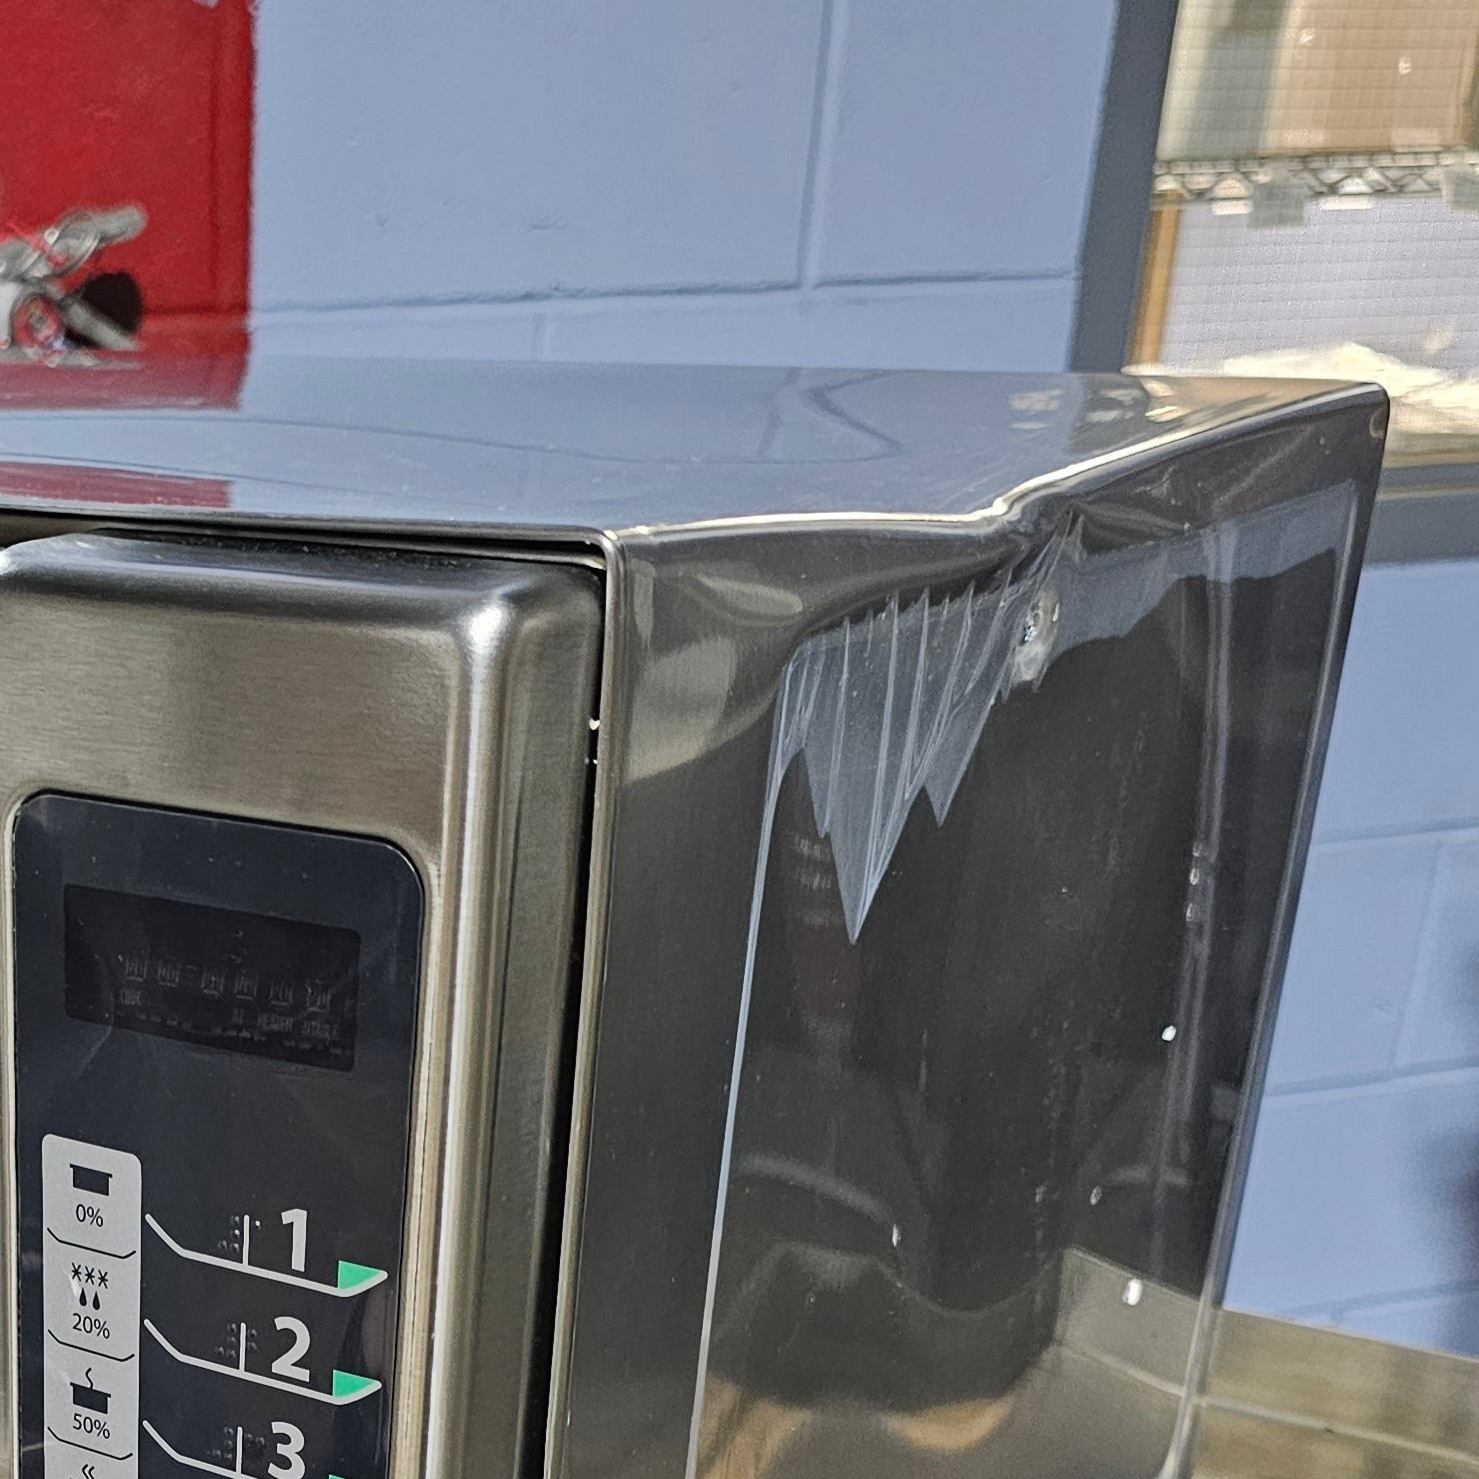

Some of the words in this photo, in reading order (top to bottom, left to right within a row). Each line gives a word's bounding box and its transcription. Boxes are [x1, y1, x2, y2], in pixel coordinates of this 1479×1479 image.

[75, 1203, 104, 1228] 0%
[281, 1208, 308, 1272] 1
[72, 1312, 111, 1340] 20%
[272, 1316, 311, 1382] 2
[72, 1412, 111, 1440] 50%
